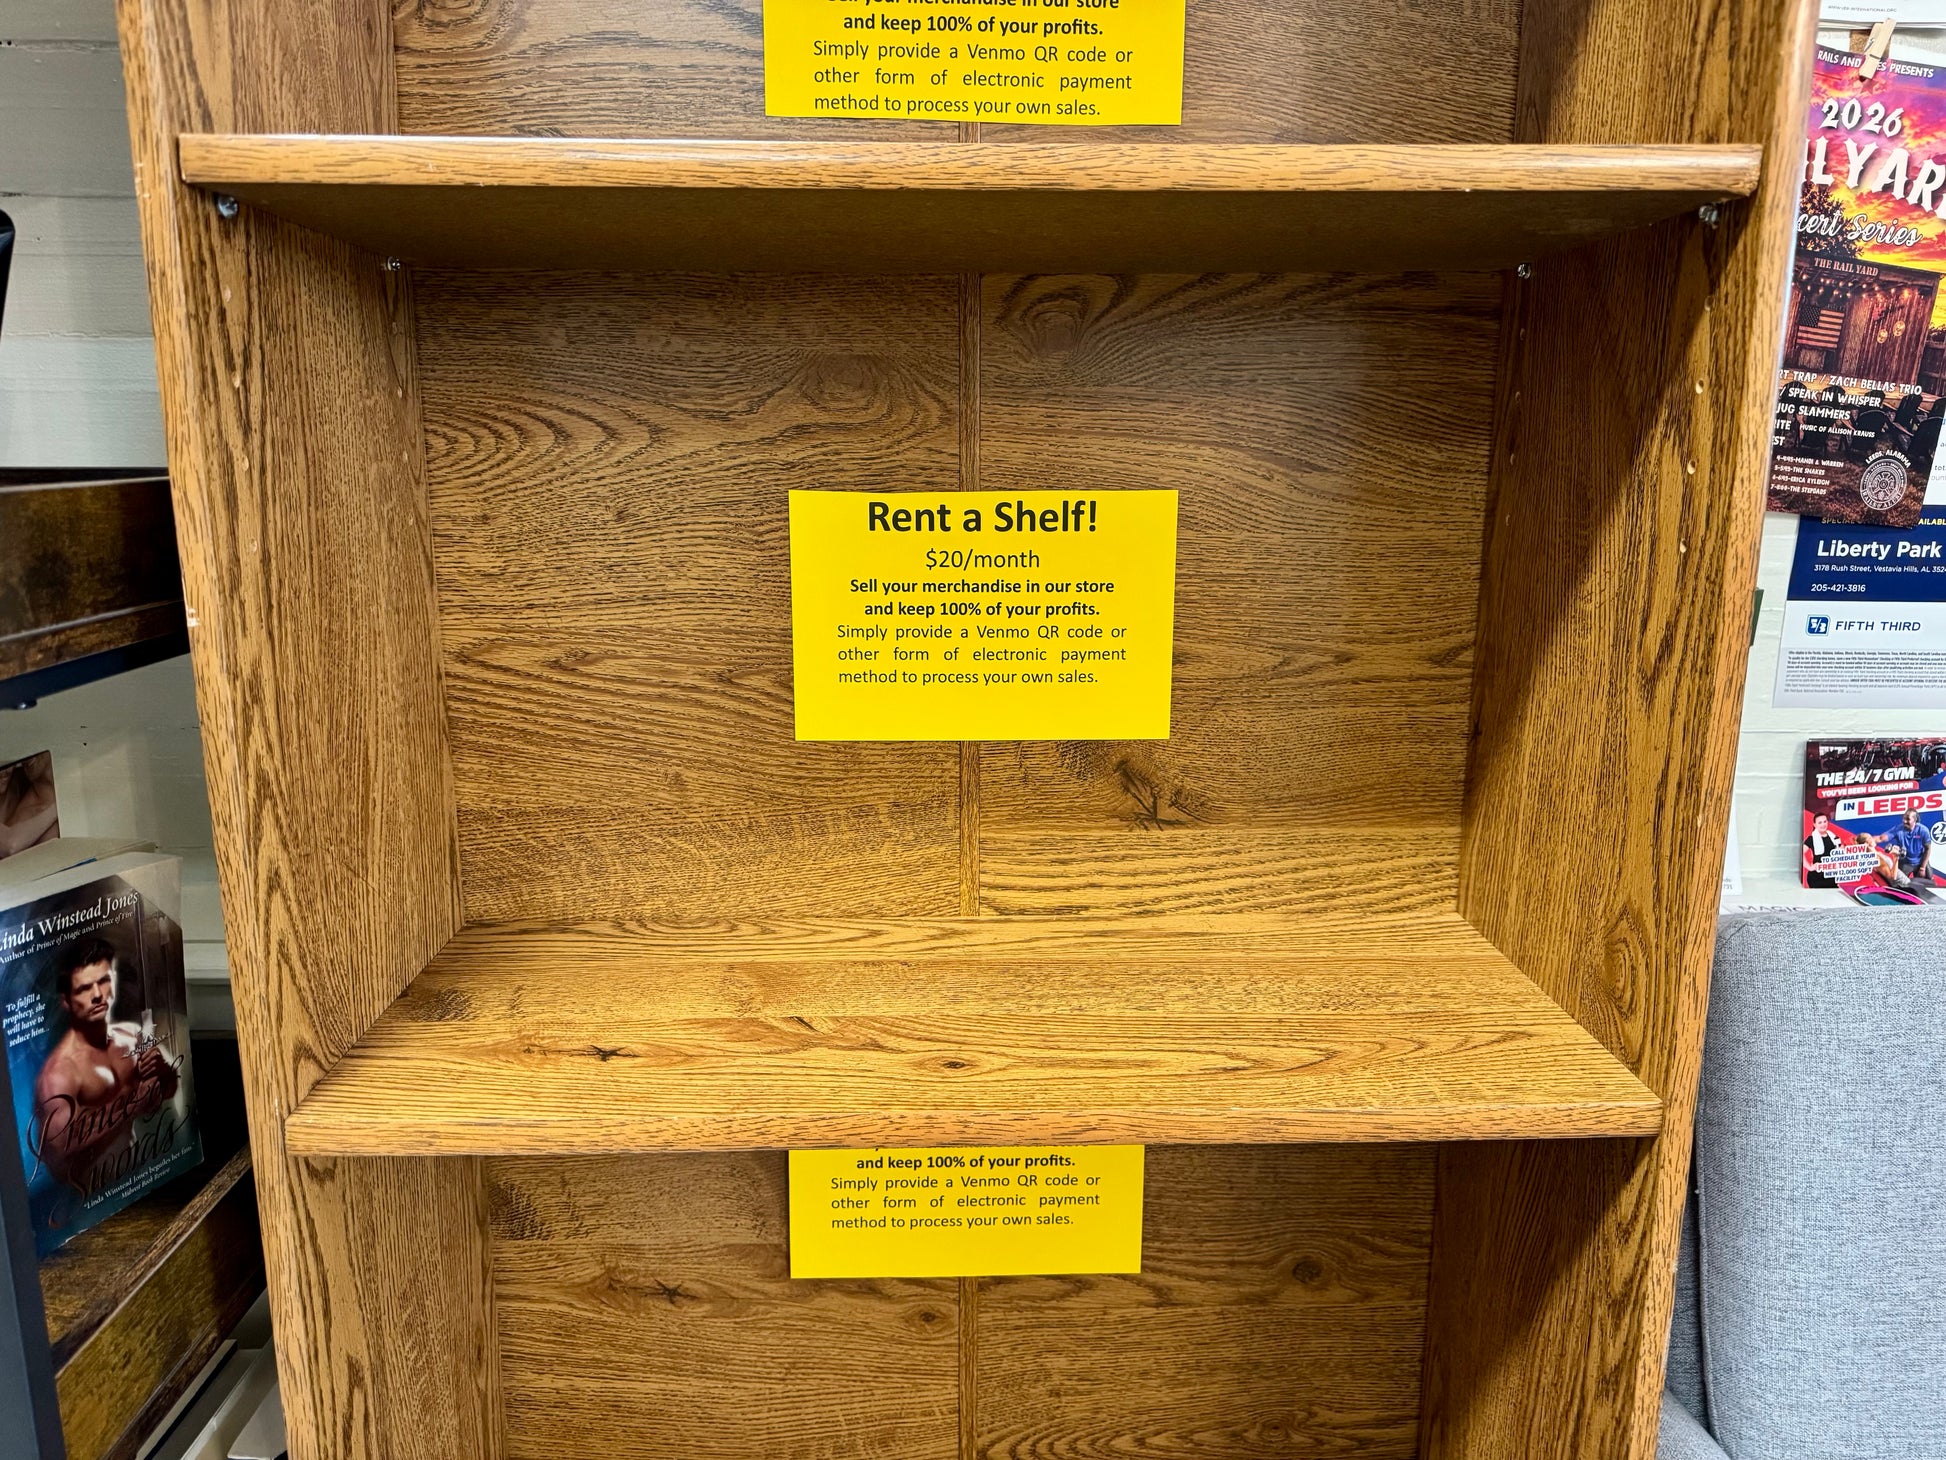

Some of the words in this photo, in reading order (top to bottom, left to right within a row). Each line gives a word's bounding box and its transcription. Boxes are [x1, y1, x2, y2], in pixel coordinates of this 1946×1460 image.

[843, 14, 874, 29] and
[881, 14, 921, 34] keep
[927, 16, 972, 31] 100%
[977, 17, 995, 32] of
[999, 22, 1038, 36] your
[1043, 19, 1102, 37] profits.
[813, 40, 868, 60] Simply
[878, 43, 940, 60] provide
[949, 48, 957, 58] a
[967, 44, 1025, 60] Venmo
[1034, 46, 1057, 62] QR
[1067, 46, 1106, 61] code
[1115, 51, 1133, 62] or
[1817, 50, 1839, 64] RAILS
[1840, 56, 1862, 68] AND
[1889, 62, 1935, 78] PRESENTS
[814, 67, 859, 82] other
[875, 68, 914, 84] form
[930, 70, 947, 85] of
[962, 70, 1043, 87] electronic
[1060, 76, 1131, 91] payment
[815, 94, 878, 110] method
[884, 97, 900, 110] to
[907, 101, 968, 114] process
[973, 102, 1011, 115] your
[1016, 103, 1050, 114] own
[1056, 100, 1099, 115] sales.
[1818, 98, 1905, 138] 2026
[1847, 213, 1924, 247] Series
[1814, 257, 1833, 269] THE
[1833, 260, 1854, 273] RAIL
[1855, 264, 1879, 277] YARD
[1793, 370, 1818, 383] TRAP
[1828, 375, 1857, 388] ZACH
[1861, 379, 1896, 393] BELLAS
[1899, 383, 1923, 396] TRIO
[1788, 387, 1818, 400] SPEAK
[1822, 392, 1833, 402] IN
[1837, 393, 1881, 408] WHISPER
[1776, 402, 1795, 414] JUG
[1798, 405, 1851, 420] SLAMMERS
[868, 502, 951, 532] Rent
[962, 510, 981, 532] a
[994, 501, 1096, 532] Shelf!
[925, 548, 1039, 571] $20/month
[1817, 540, 1891, 560] Liberty
[1896, 540, 1943, 558] Park
[1850, 565, 1872, 573] Street,
[1874, 565, 1902, 573] Vestavia
[850, 579, 877, 592] Sell
[881, 583, 917, 595] your
[922, 579, 1021, 592] merchandise
[1026, 580, 1039, 592] in
[1044, 583, 1071, 592] our
[1075, 581, 1114, 592] store
[1811, 584, 1866, 592] 205-421-3816
[864, 602, 893, 615] and
[898, 602, 934, 618] keep
[940, 603, 981, 615] 100%
[985, 602, 1002, 615] of
[1005, 606, 1041, 618] your
[1045, 602, 1099, 618] profits.
[837, 625, 887, 640] Simply
[896, 625, 952, 640] provide
[960, 629, 968, 638] a
[976, 626, 1029, 638] Venmo
[1037, 626, 1059, 639] QR
[1067, 625, 1102, 638] code
[1111, 628, 1126, 637] or
[1835, 621, 1875, 631] FIFTH
[1881, 621, 1922, 632] THIRD
[838, 647, 879, 660] other
[893, 647, 928, 660] form
[943, 647, 959, 660] of
[972, 648, 1046, 660] electronic
[1061, 649, 1126, 663] payment
[839, 670, 896, 682] method
[902, 672, 917, 682] to
[922, 674, 978, 685] process
[982, 674, 1017, 685] your
[1021, 674, 1052, 683] own
[1057, 670, 1097, 682] sales.
[1816, 772, 1845, 787] THE
[1845, 768, 1882, 785] 24/7
[1883, 766, 1915, 782] GYM
[1821, 787, 1848, 798] YOU'VE
[1848, 785, 1866, 795] BEEN
[1867, 783, 1899, 794] LOOKING
[1899, 781, 1914, 790] FOR
[1843, 802, 1855, 812] IN
[1857, 793, 1943, 816] LEEDS
[1846, 846, 1866, 854] NOW
[1838, 861, 1858, 869] TOUR
[37, 897, 102, 937] Winstead
[102, 891, 138, 919] Jones
[0, 949, 26, 964] Author
[26, 945, 36, 954] of
[36, 938, 56, 952] Prince
[55, 935, 63, 946] of
[63, 930, 82, 943] Magic
[82, 923, 95, 934] and
[96, 917, 114, 929] Prince
[114, 913, 122, 923] of
[5, 1003, 16, 1013] To
[15, 993, 35, 1012] fulfill
[36, 993, 41, 1001] a
[3, 1008, 35, 1029] prophecy,
[35, 1002, 46, 1013] she
[7, 1023, 20, 1036] will
[21, 1018, 37, 1030] have
[9, 1033, 31, 1048] seduce
[856, 1157, 883, 1168] and
[888, 1157, 922, 1170] keep
[927, 1156, 965, 1167] 100%
[969, 1155, 984, 1167] of
[987, 1158, 1020, 1169] your
[1024, 1154, 1075, 1169] profits.
[831, 1177, 877, 1191] Simply
[885, 1176, 937, 1191] provide
[945, 1179, 952, 1187] a
[960, 1176, 1009, 1187] Venmo
[1017, 1175, 1037, 1186] QR
[1045, 1174, 1078, 1185] code
[1085, 1177, 1100, 1185] or
[831, 1198, 869, 1208] other
[883, 1196, 916, 1207] form
[929, 1196, 944, 1207] of
[957, 1195, 1025, 1207] electronic
[1039, 1195, 1099, 1207] payment
[832, 1216, 886, 1228] method
[891, 1218, 905, 1227] to
[910, 1218, 962, 1229] process
[966, 1217, 997, 1228] your
[1002, 1217, 1031, 1225] own
[1036, 1214, 1073, 1224] sales.
